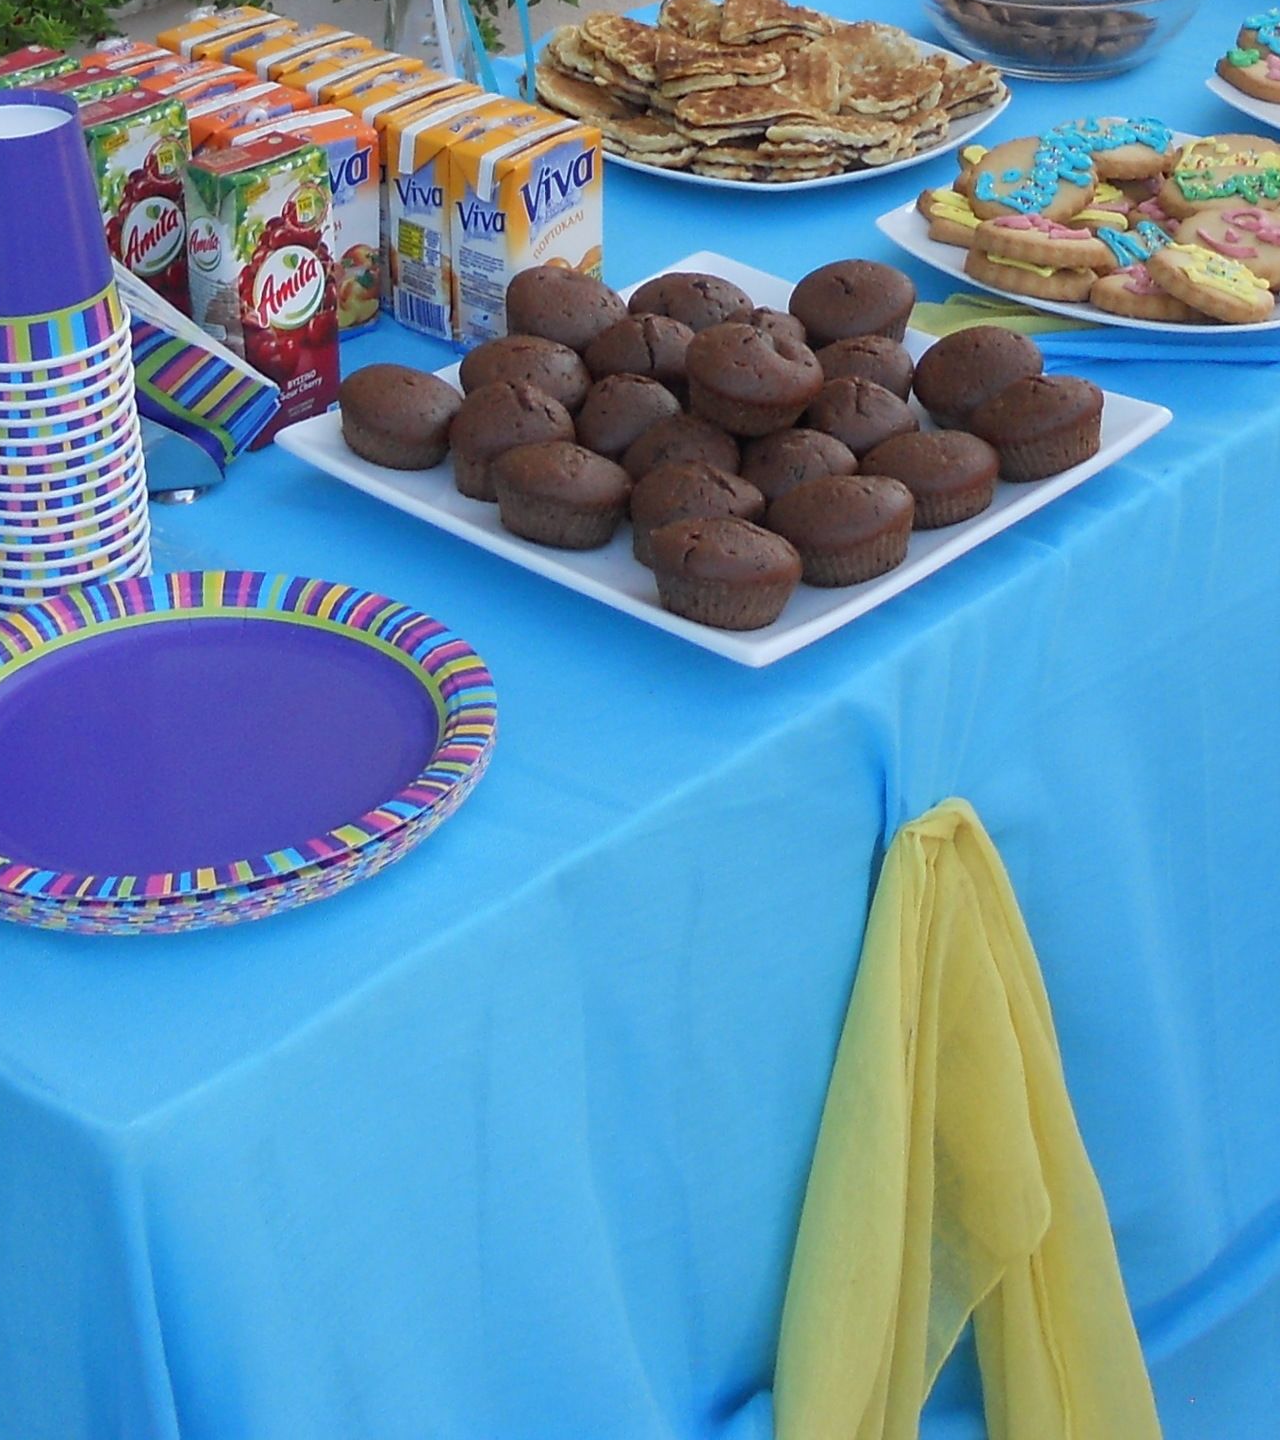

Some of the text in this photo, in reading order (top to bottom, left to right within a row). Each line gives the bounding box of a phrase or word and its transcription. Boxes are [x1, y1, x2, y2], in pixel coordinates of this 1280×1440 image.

[329, 146, 372, 195] va
[394, 178, 443, 207] Viva
[519, 146, 597, 224] Viva
[124, 208, 180, 270] Amita
[189, 229, 219, 254] Amita
[455, 201, 506, 233] Viva
[258, 256, 319, 328] Amita
